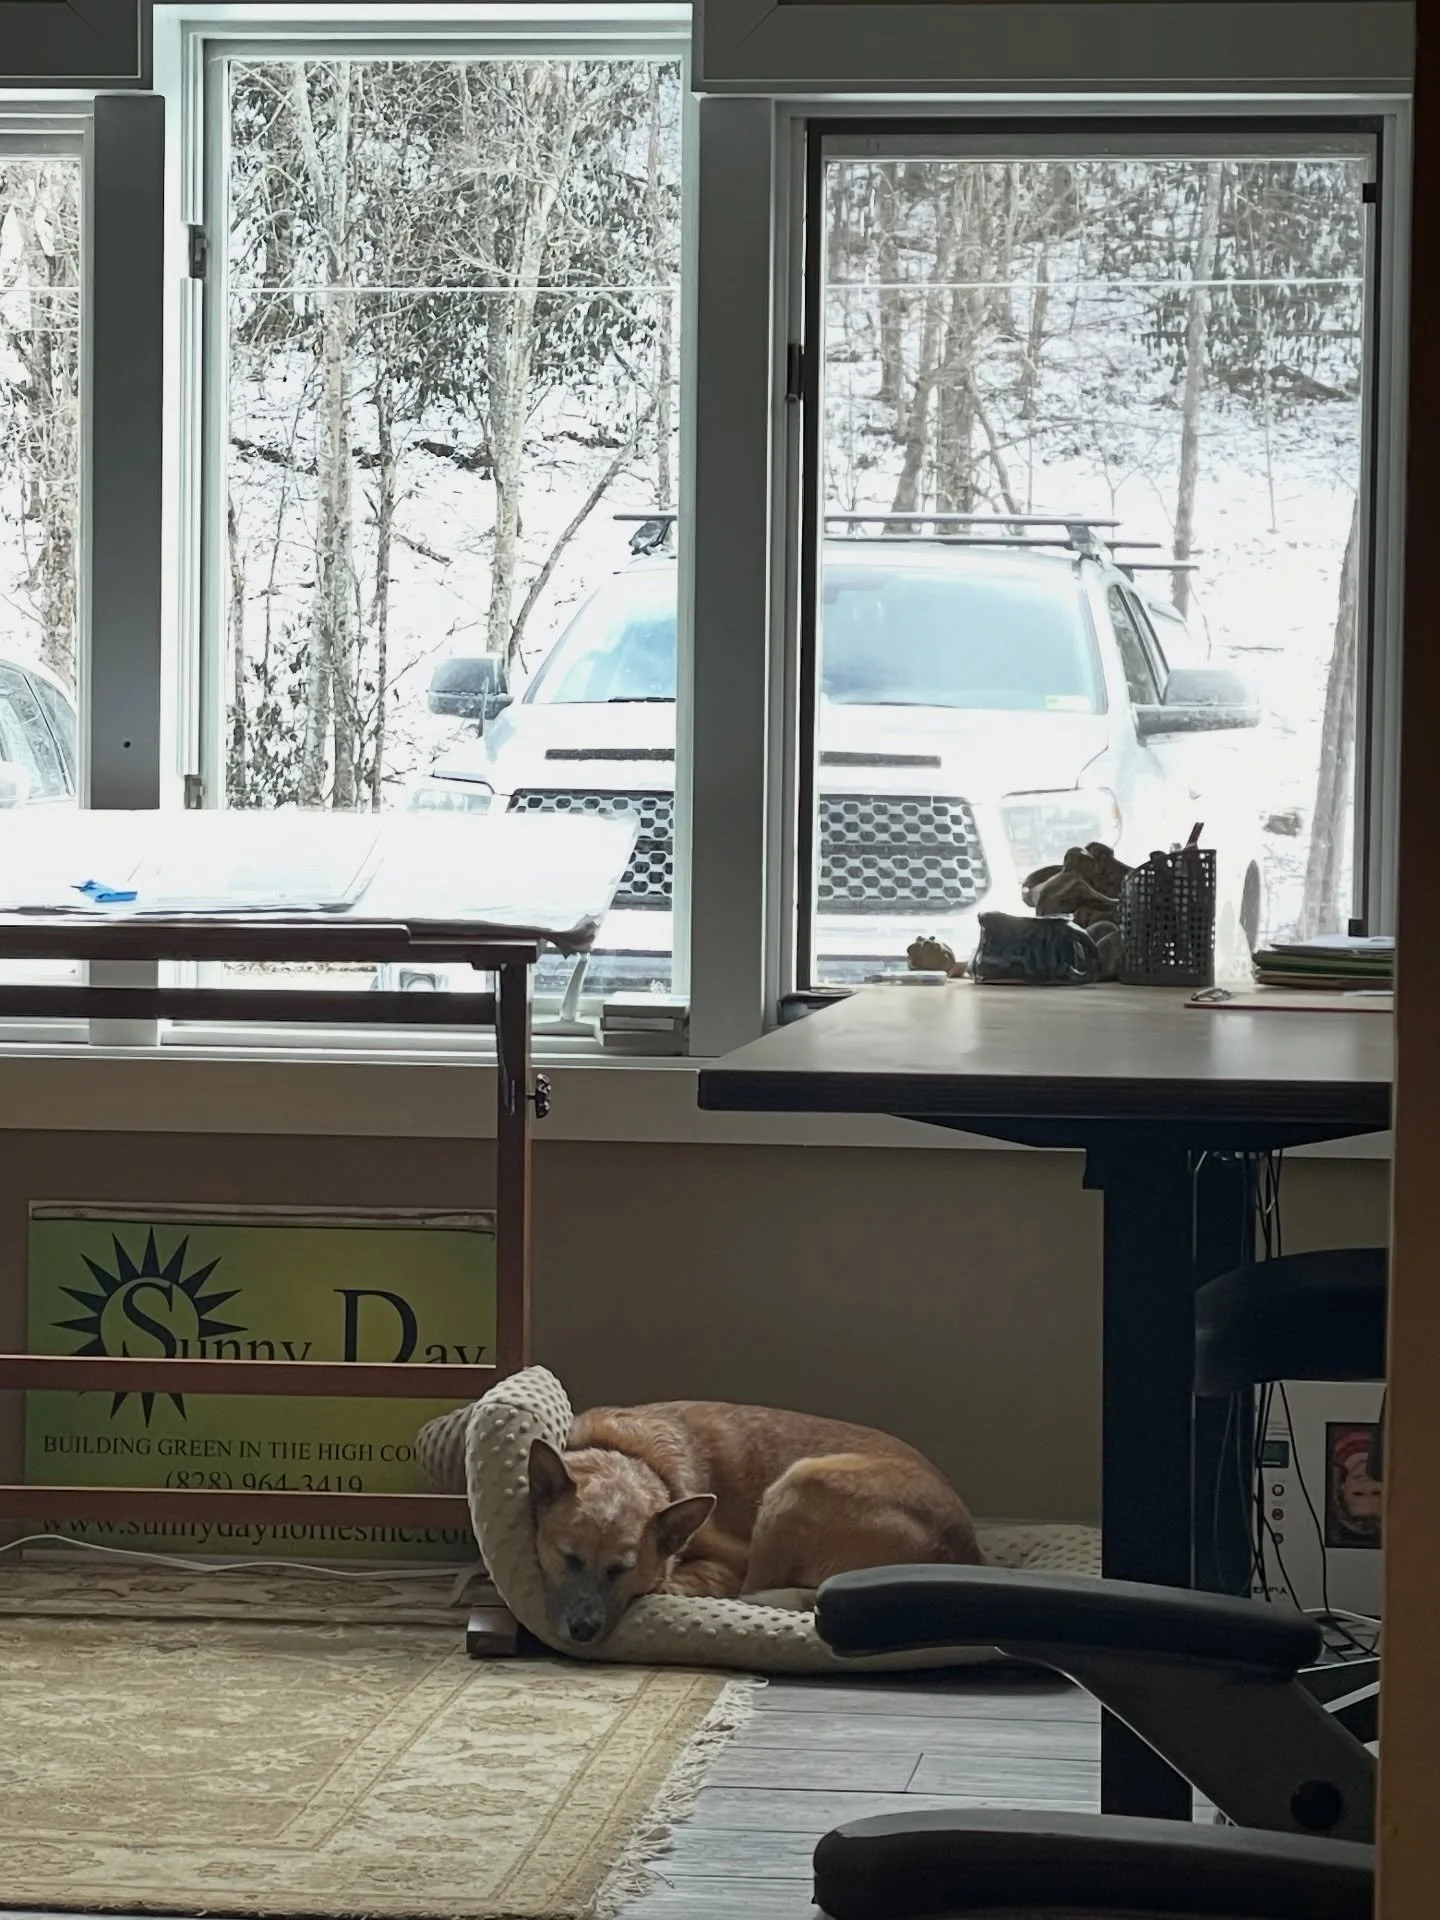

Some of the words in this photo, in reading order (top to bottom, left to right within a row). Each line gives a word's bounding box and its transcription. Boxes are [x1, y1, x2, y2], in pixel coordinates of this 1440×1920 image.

[44, 1435, 150, 1456] BUILDING
[157, 1439, 233, 1458] GREEN
[239, 1440, 262, 1459] IN
[267, 1441, 311, 1460] THE
[318, 1442, 373, 1462] HIGH
